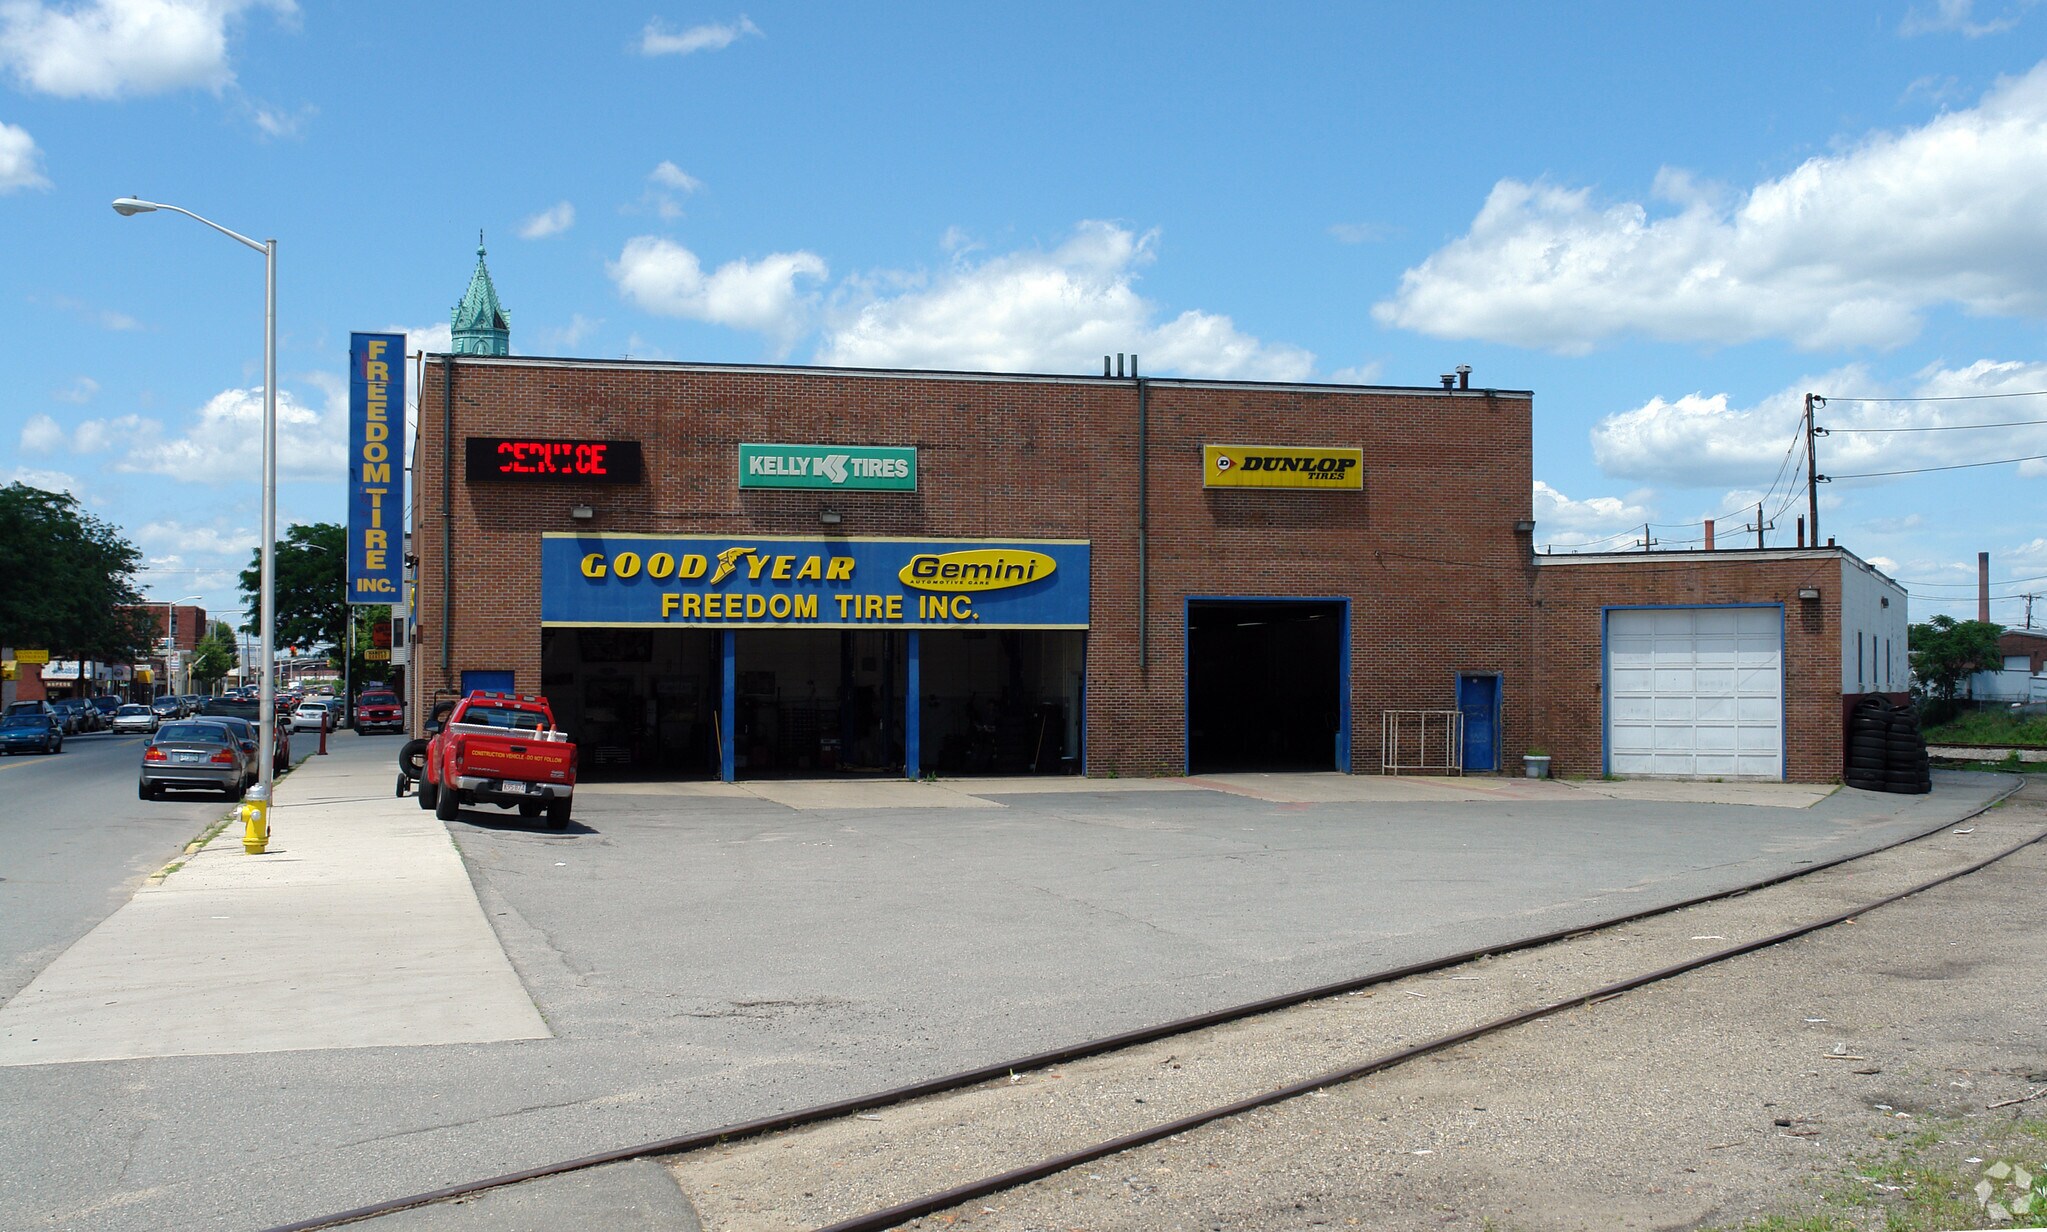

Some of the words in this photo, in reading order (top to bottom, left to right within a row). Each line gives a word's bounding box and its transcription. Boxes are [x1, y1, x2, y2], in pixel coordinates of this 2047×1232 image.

[363, 340, 390, 483] FREEDOM
[749, 456, 811, 476] KELLY
[851, 458, 909, 478] TIRES
[1240, 457, 1356, 472] DUNLOP
[1308, 472, 1345, 480] TIRES
[365, 488, 387, 570] TIRE
[912, 557, 1036, 579] Gemini
[356, 578, 396, 592] INC.
[662, 593, 818, 618] FREEDOM
[834, 594, 903, 619] TIRE
[919, 595, 980, 620] INC.
[471, 750, 506, 758] CONSTRUCTION
